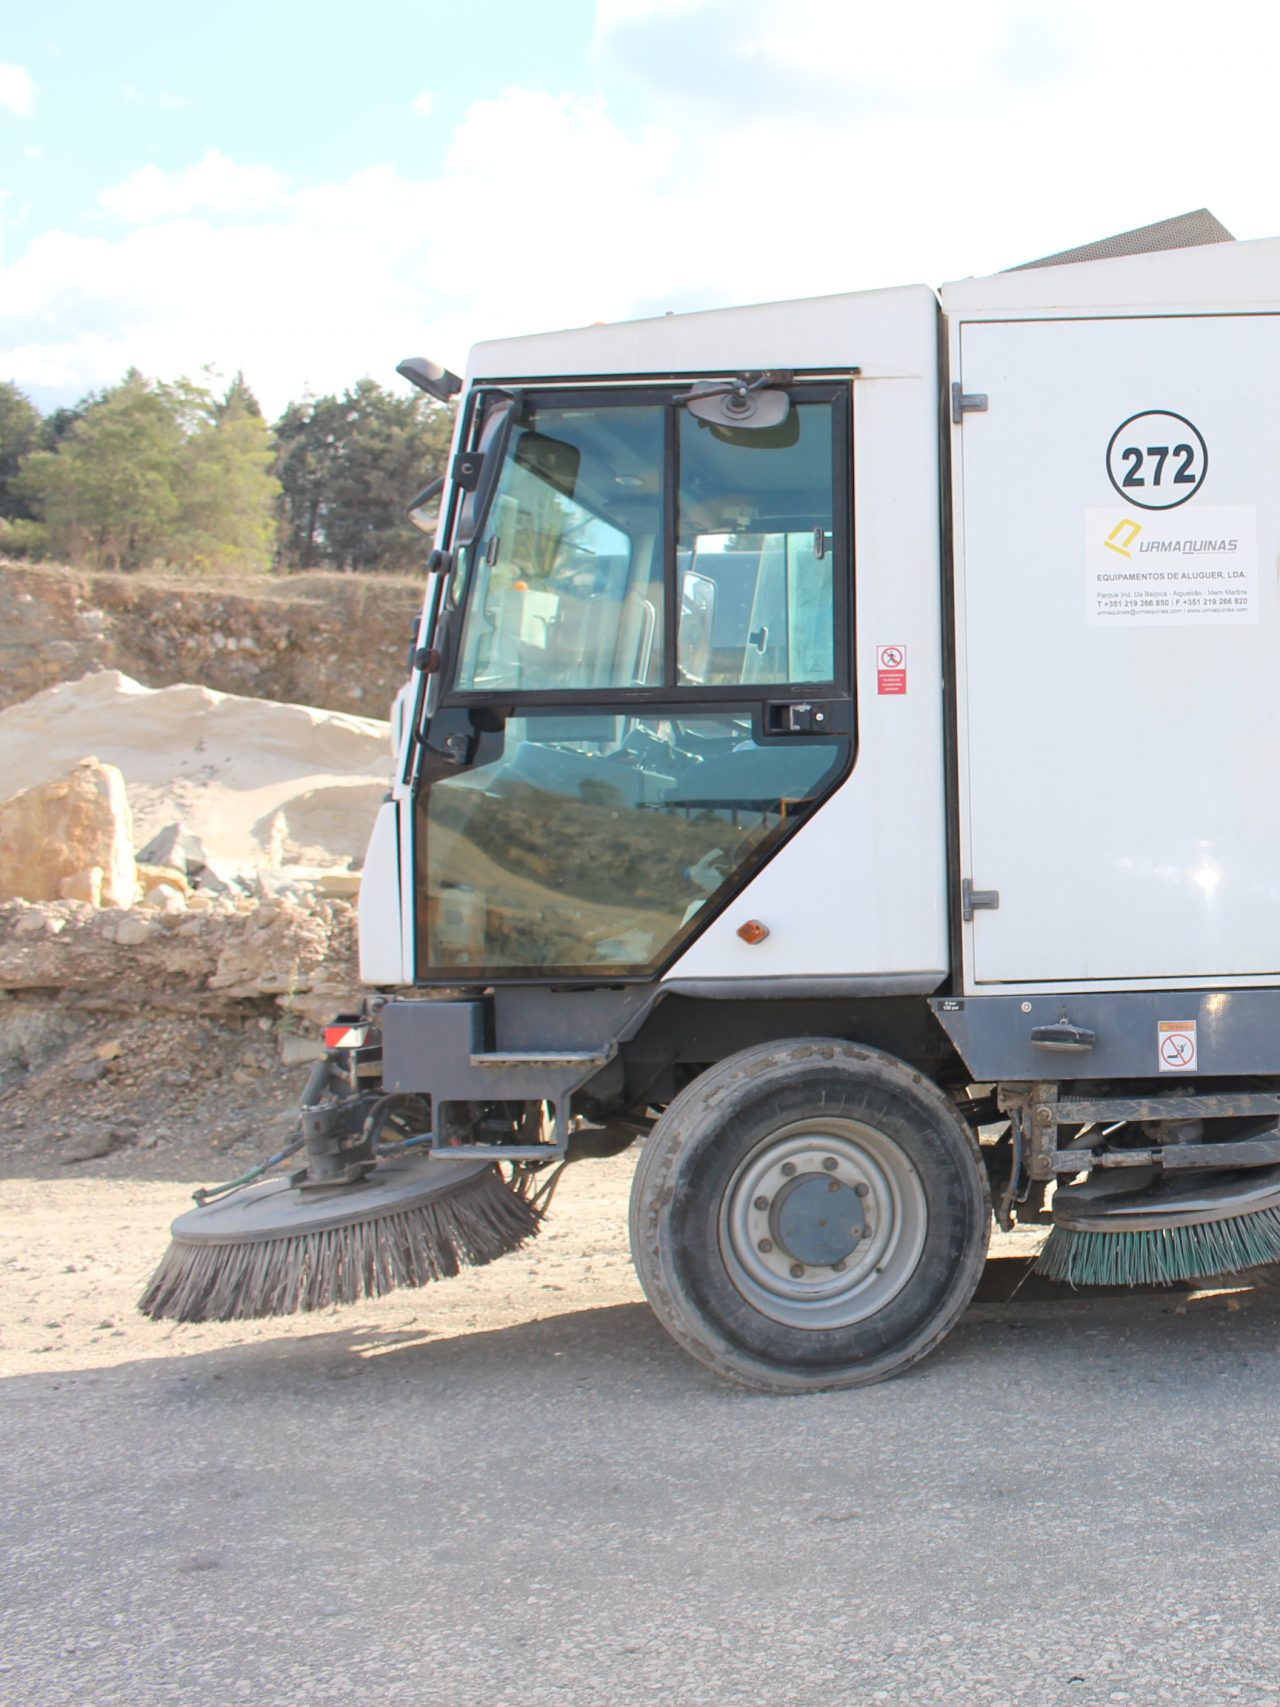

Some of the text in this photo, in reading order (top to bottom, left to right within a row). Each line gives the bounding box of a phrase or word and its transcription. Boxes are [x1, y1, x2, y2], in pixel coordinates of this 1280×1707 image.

[1121, 443, 1196, 487] 272
[1139, 539, 1239, 554] URMAQUINAS
[1096, 571, 1247, 582] EQUIPAMENTOS DE ALUGUER, LDA.
